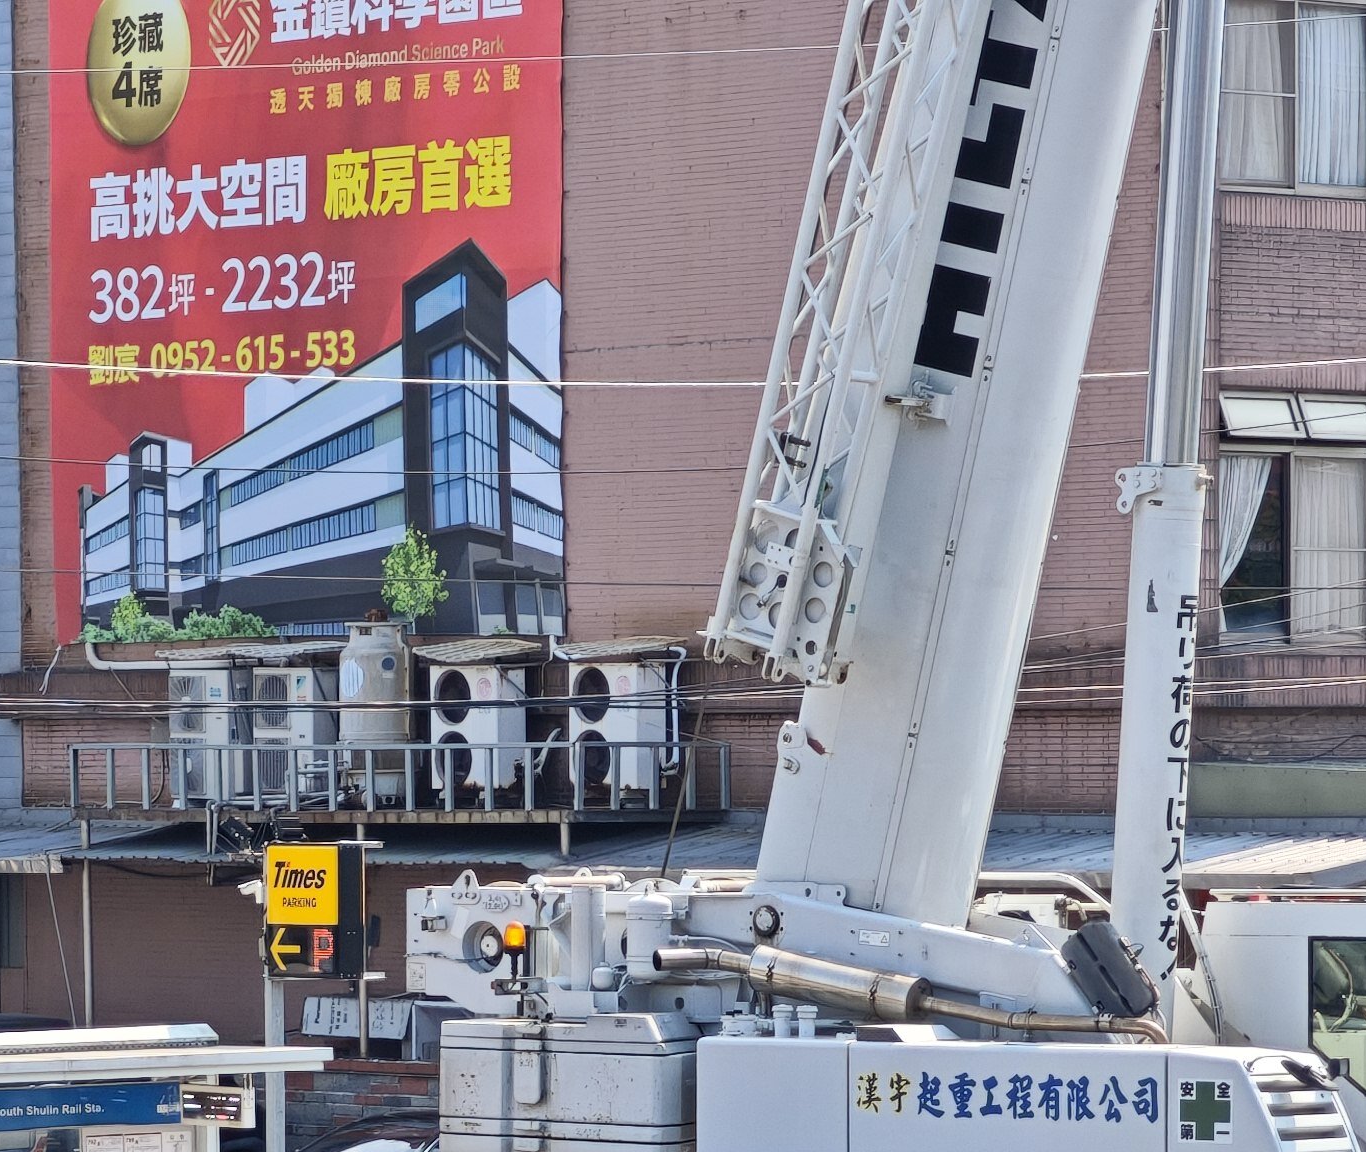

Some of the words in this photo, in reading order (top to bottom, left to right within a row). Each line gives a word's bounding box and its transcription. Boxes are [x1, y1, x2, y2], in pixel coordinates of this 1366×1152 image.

[111, 12, 164, 55] 珍藏
[292, 53, 341, 76] Golden
[344, 47, 408, 71] Diamond
[411, 42, 469, 62] Science
[472, 35, 505, 56] Park
[111, 62, 164, 108] 4席
[90, 155, 307, 242] 高挑大空間
[323, 136, 512, 221] 廠房首選
[89, 263, 195, 324] 382坪
[221, 250, 356, 313] 2232坪
[273, 861, 327, 889] Times
[282, 897, 317, 908] PARKING
[312, 928, 334, 972] P
[26, 1104, 60, 1117] Shulin
[62, 1104, 83, 1115] Rail
[84, 1102, 105, 1114] Sta.
[856, 1072, 1159, 1124] 漢宇起重工程有限公司
